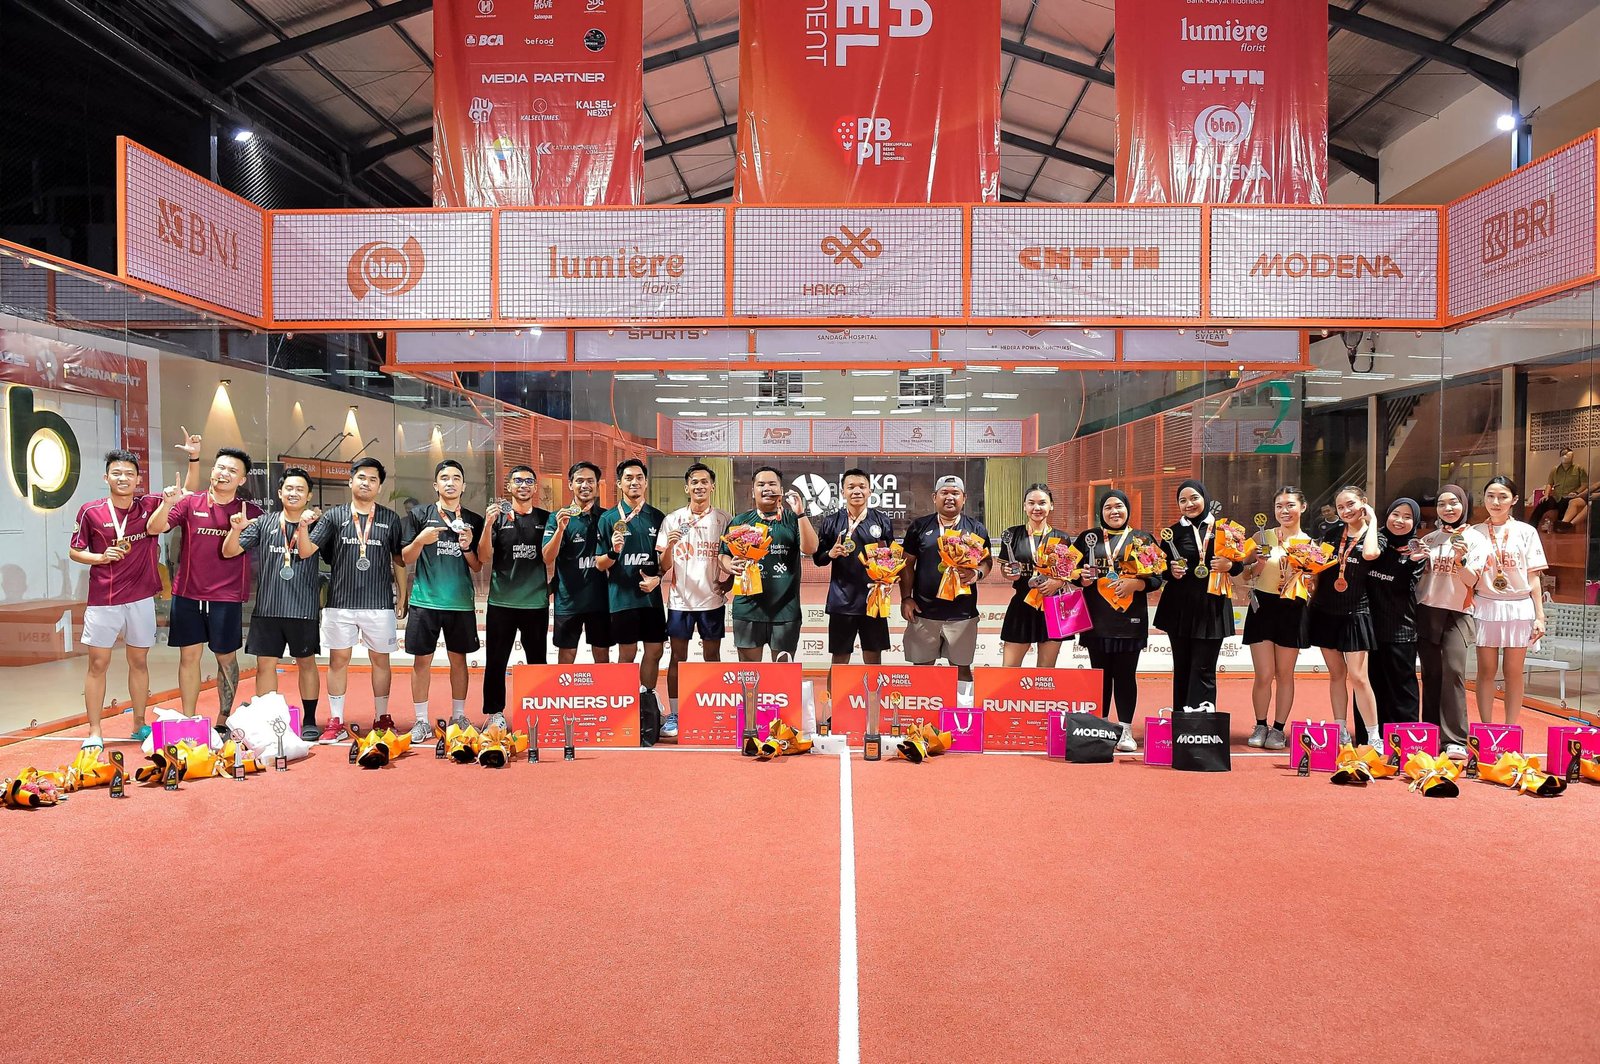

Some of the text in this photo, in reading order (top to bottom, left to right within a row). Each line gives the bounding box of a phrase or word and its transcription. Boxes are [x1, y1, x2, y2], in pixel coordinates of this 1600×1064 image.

[1181, 17, 1268, 42] lumière
[479, 35, 504, 46] BCA
[1240, 42, 1266, 52] florist
[481, 73, 605, 83] MEDIA PARTNER
[576, 100, 613, 109] KALSEL
[1512, 194, 1556, 251] BRI
[188, 211, 239, 271] BNI
[547, 245, 686, 279] lumière
[1248, 252, 1405, 279] MODENA
[640, 280, 682, 296] florist
[55, 609, 74, 653] 1
[522, 695, 635, 710] RUNNERS UP
[983, 699, 1097, 713] RUNNERS UP
[1072, 727, 1118, 740] MODENA
[1176, 734, 1224, 745] MODENA
